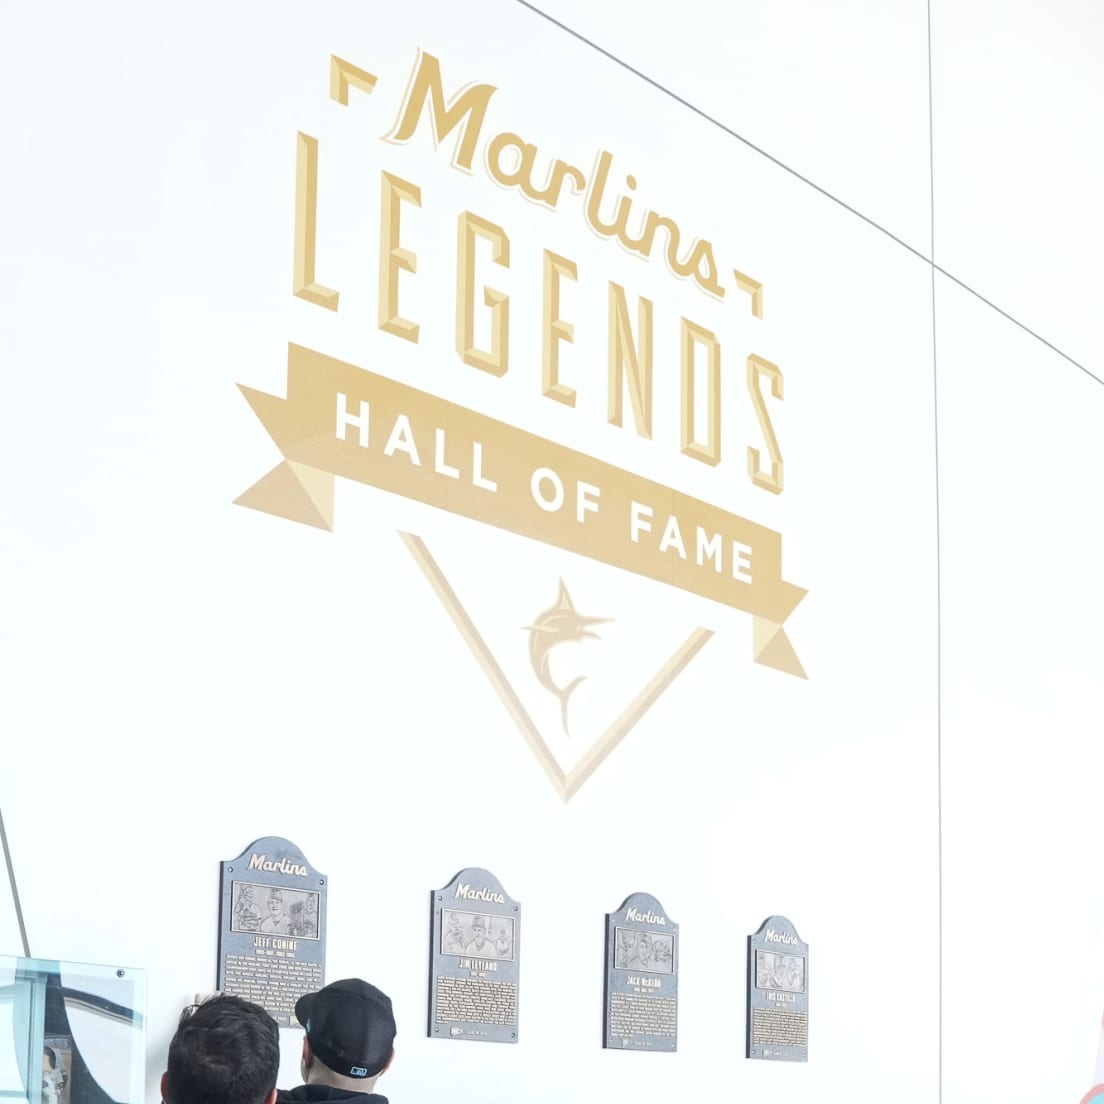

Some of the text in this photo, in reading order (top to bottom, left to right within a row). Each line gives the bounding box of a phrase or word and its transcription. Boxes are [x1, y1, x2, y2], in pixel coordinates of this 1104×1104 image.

[379, 45, 727, 304] Marlins
[292, 129, 785, 497] LEGENDS
[334, 391, 754, 585] HALL OF FAME
[247, 853, 309, 877] Marlins
[454, 883, 505, 904] Marlins
[625, 907, 666, 925] Marlins
[253, 936, 270, 948] JEFF
[764, 929, 798, 945] Marlins
